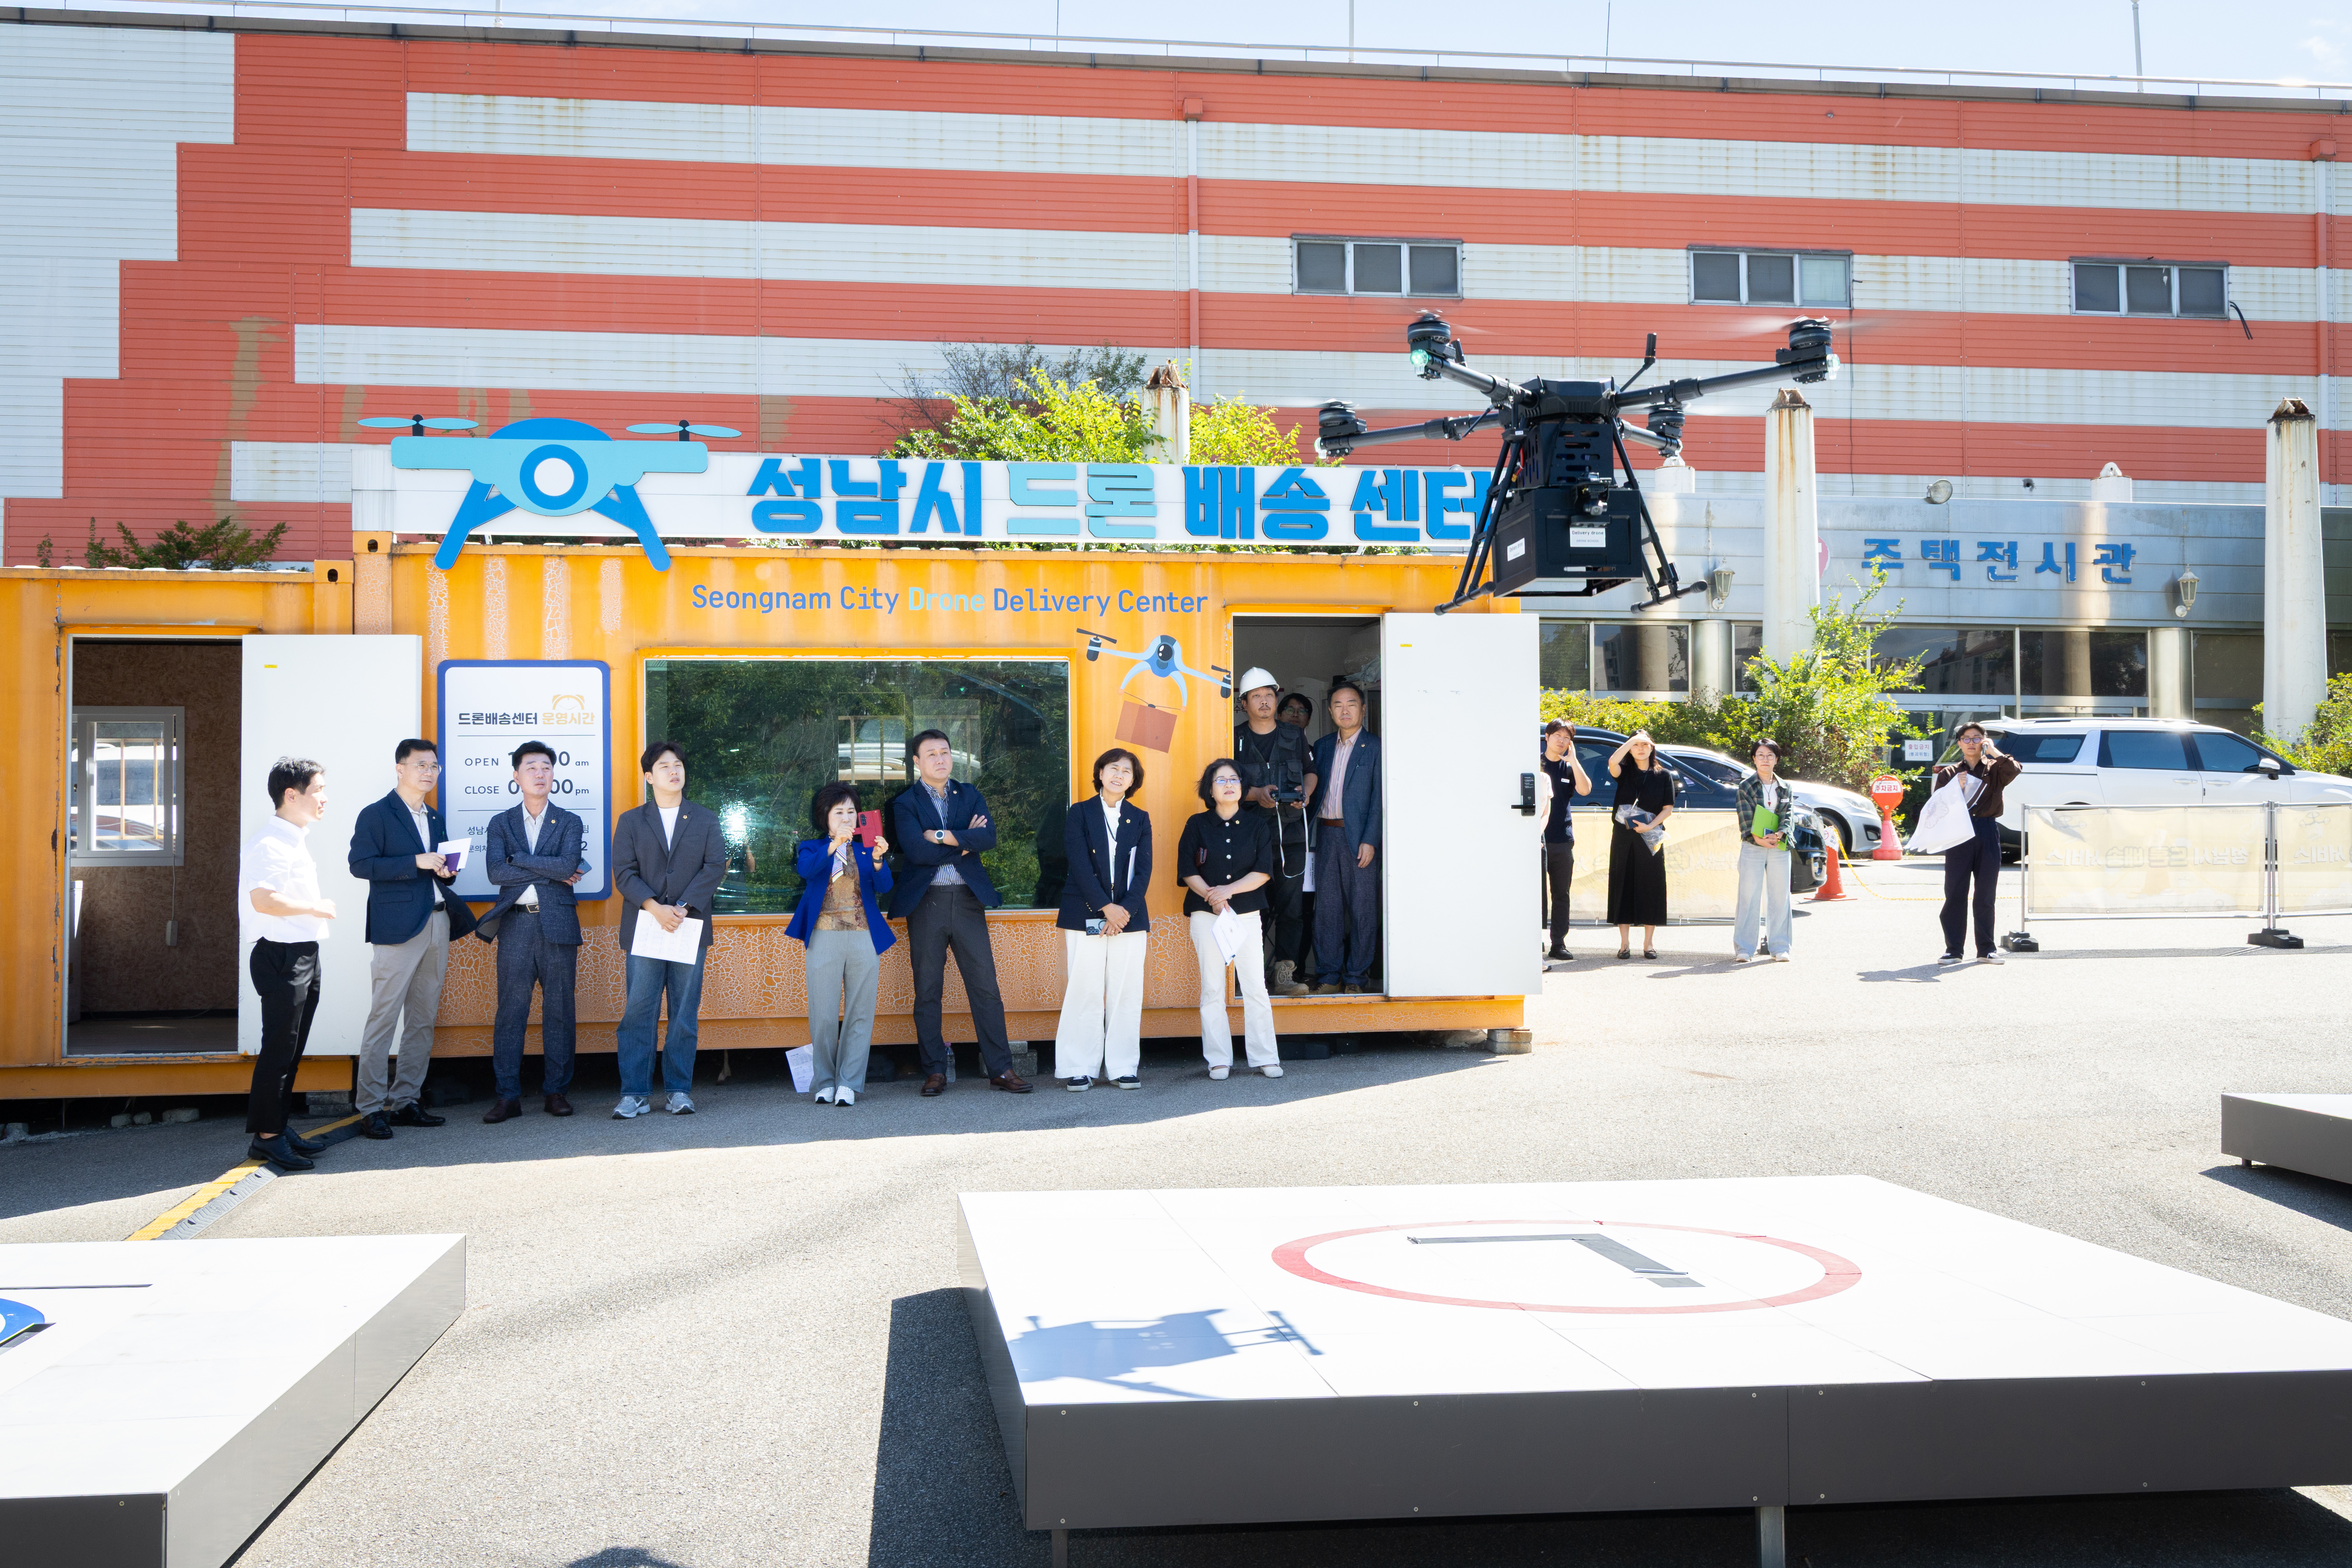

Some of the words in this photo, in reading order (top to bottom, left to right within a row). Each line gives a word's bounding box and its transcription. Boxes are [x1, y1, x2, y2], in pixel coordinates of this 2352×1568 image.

[746, 458, 982, 536] 성남시
[1007, 463, 1157, 539] 드론
[1181, 466, 1330, 541] 배송
[1350, 469, 1491, 541] 센터
[1862, 538, 2136, 584] 주택전시관
[692, 584, 831, 614] Seongnam
[840, 586, 899, 614] City
[908, 587, 985, 612] Drone
[994, 588, 1111, 617] Delivery
[1118, 589, 1208, 613] Center
[458, 712, 538, 725] 드론배송센터
[542, 712, 595, 725] 운영시간
[465, 758, 499, 766] OPEN
[465, 786, 500, 794] CLOSE
[575, 788, 590, 796] pm
